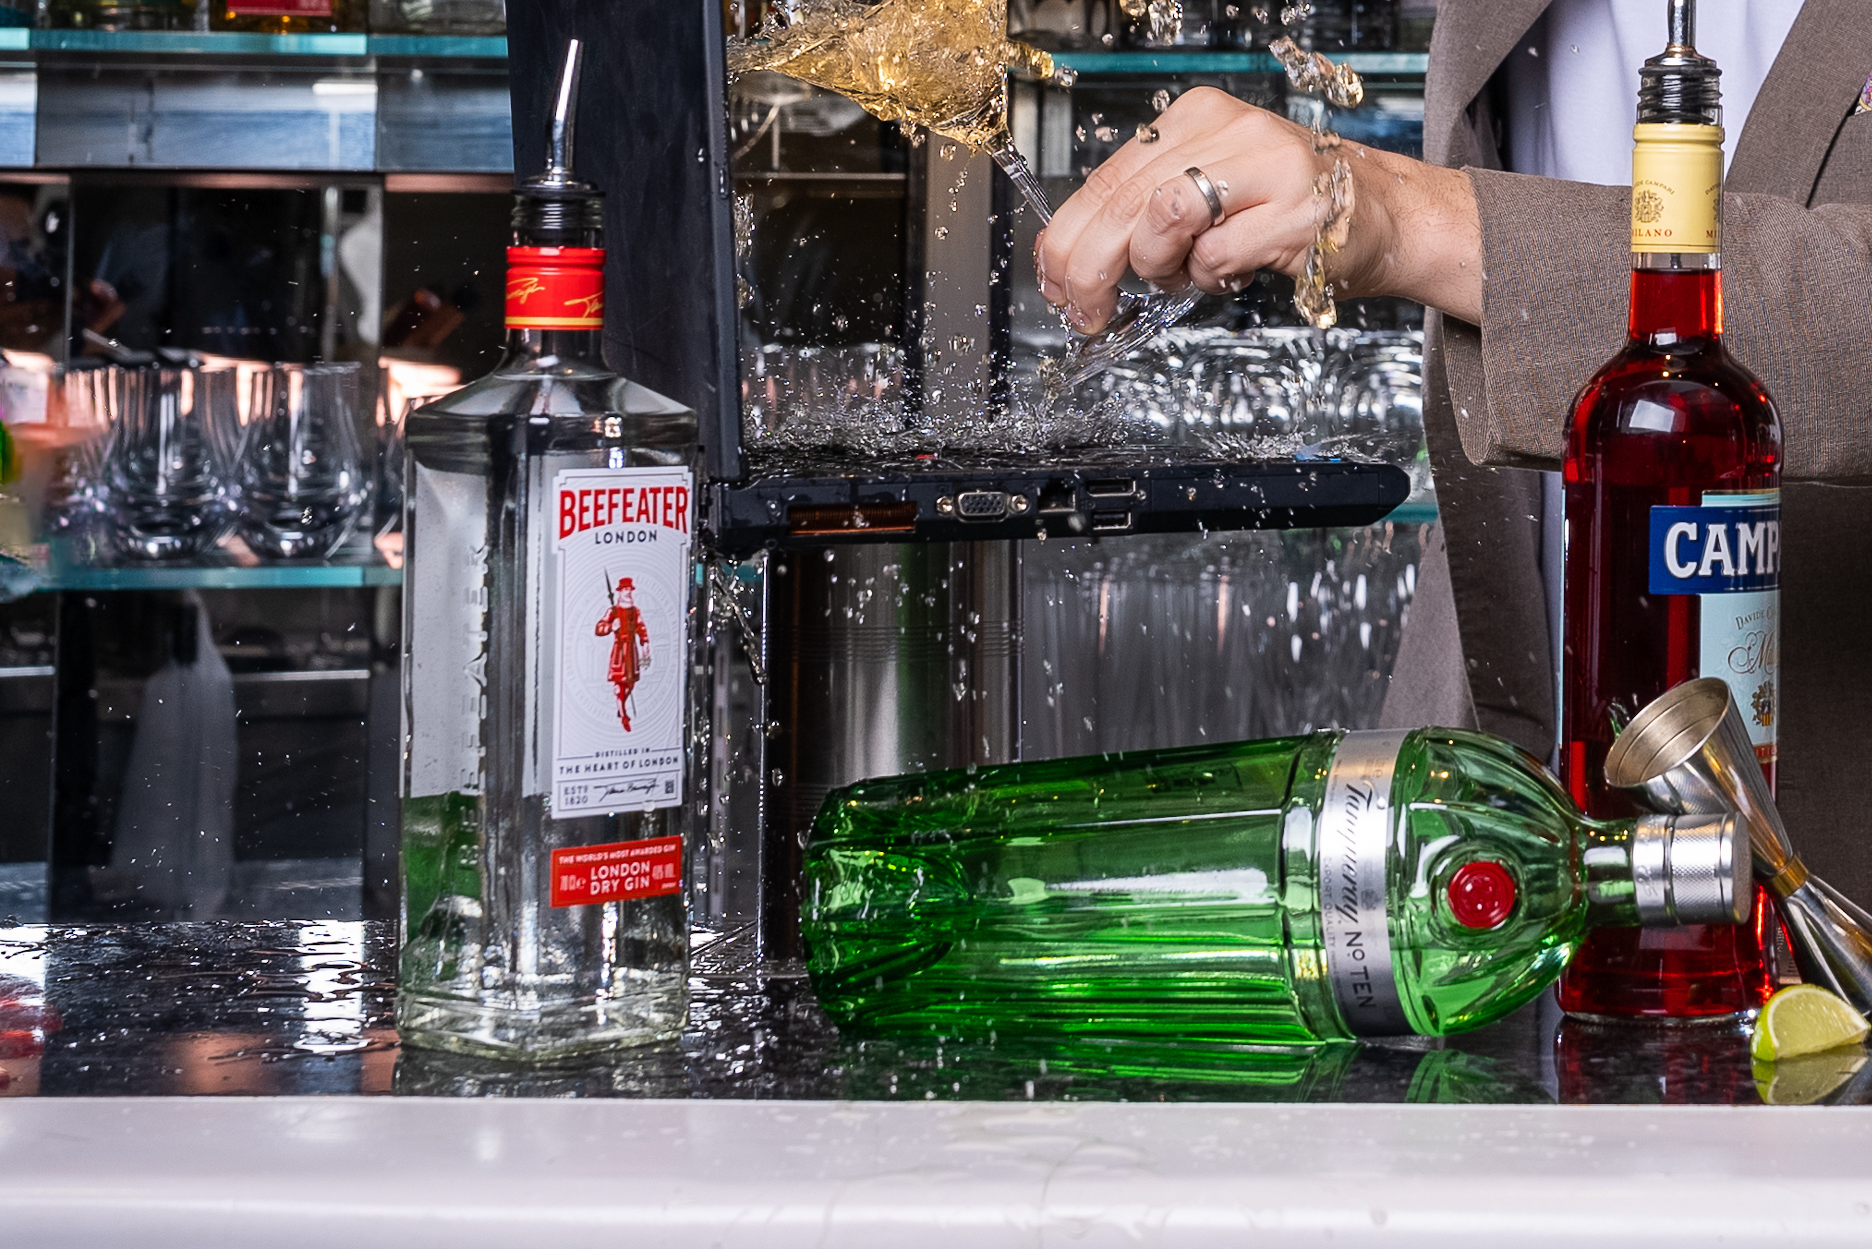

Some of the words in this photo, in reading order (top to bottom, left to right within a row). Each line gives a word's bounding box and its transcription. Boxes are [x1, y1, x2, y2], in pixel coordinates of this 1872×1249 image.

[1645, 179, 1675, 195] CAMPARI
[559, 486, 688, 540] BEEFEATER
[595, 530, 657, 545] LONDON
[595, 748, 637, 758] DISTILLED
[560, 765, 580, 774] THE
[585, 761, 619, 772] HEART
[622, 760, 635, 769] OF
[639, 756, 679, 768] LONDON
[559, 855, 574, 864] THE
[610, 849, 630, 859] MOST
[590, 861, 650, 880] LONDON
[589, 879, 620, 895] DRY
[624, 876, 650, 890] GIN
[1323, 902, 1336, 947] QUALITY
[1350, 965, 1376, 1008] TEN
